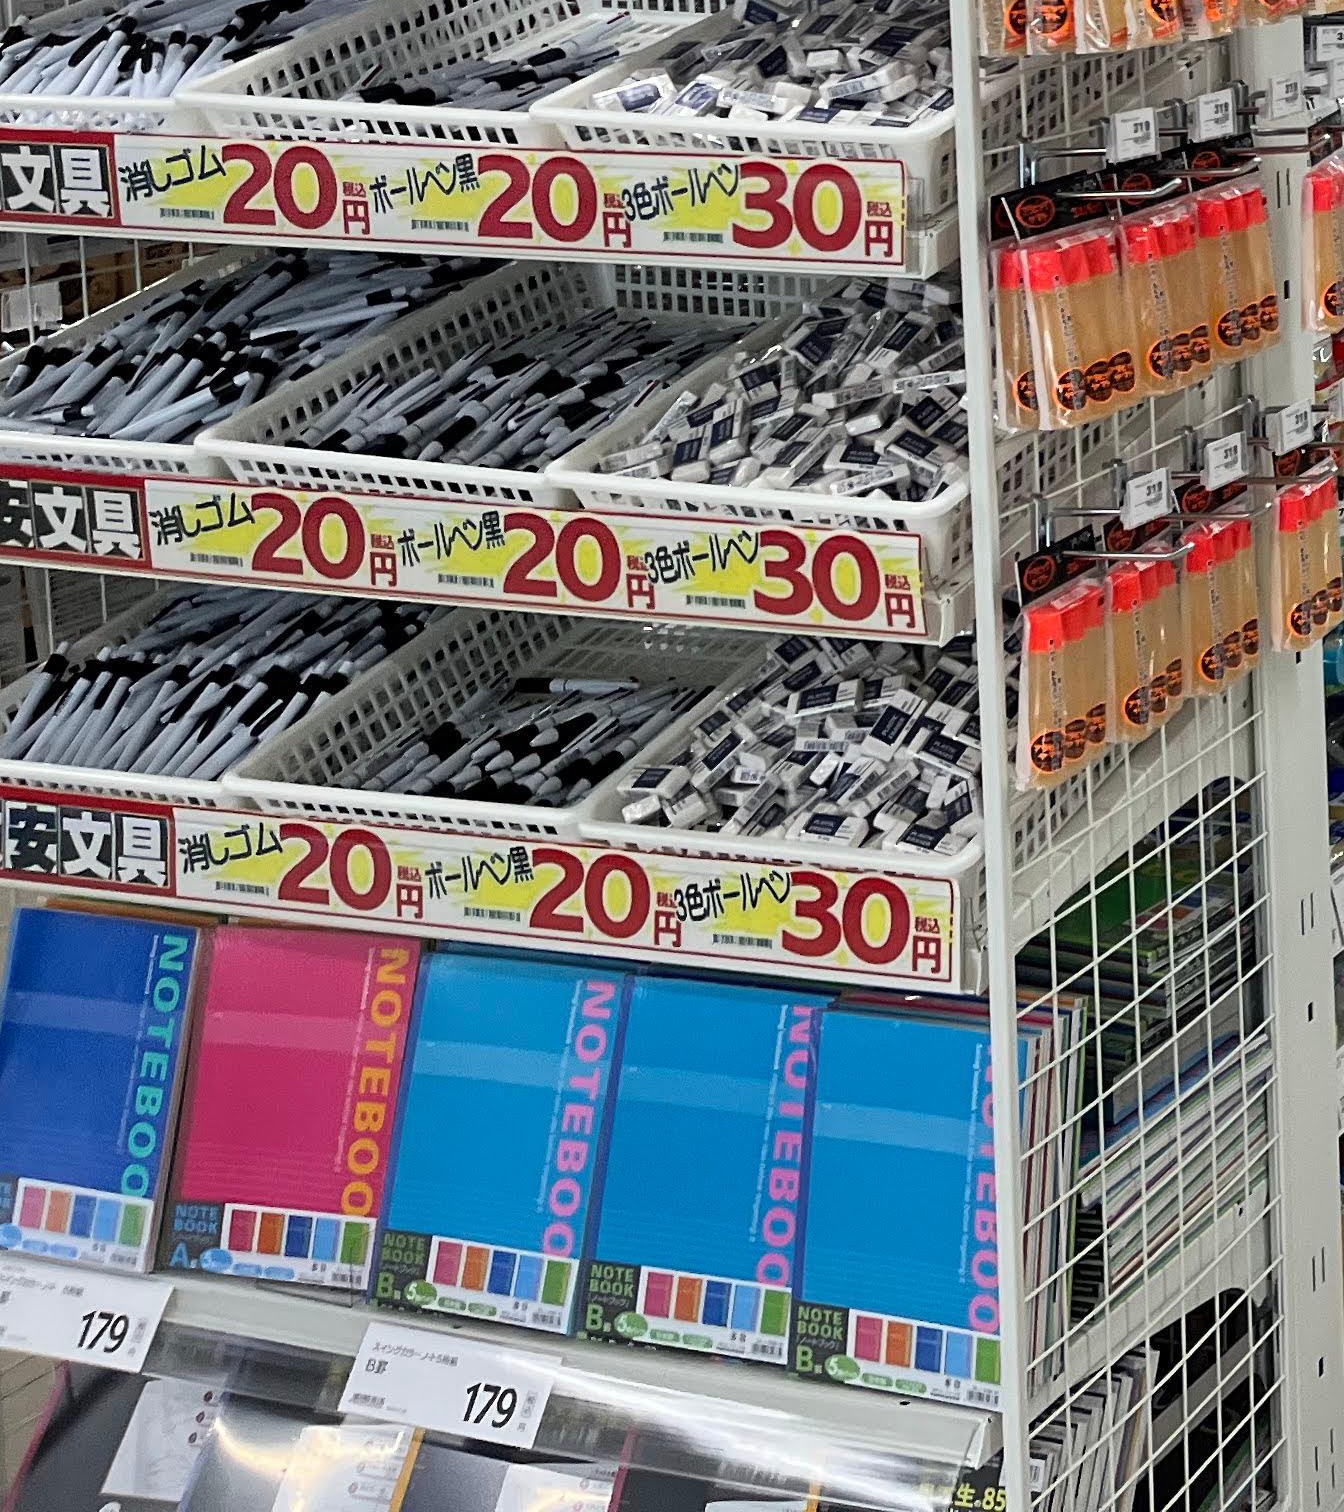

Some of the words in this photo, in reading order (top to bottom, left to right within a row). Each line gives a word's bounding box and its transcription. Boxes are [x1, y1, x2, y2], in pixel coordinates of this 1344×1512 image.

[3, 145, 114, 218] 文具
[118, 146, 227, 202] 消しゴム
[221, 143, 338, 229] 20
[342, 200, 370, 235] 円
[478, 154, 597, 242] 20
[602, 211, 632, 248] 円
[621, 163, 739, 221] 3色ボールペン
[732, 161, 863, 252] 30
[864, 221, 894, 257] 円
[150, 493, 255, 546] 消しゴム
[250, 491, 366, 581] 20
[370, 551, 398, 587] 円
[502, 511, 621, 602] 20
[625, 573, 657, 610] 円
[646, 530, 759, 585] 3色ボールペン
[753, 529, 882, 621] 30
[884, 593, 915, 628] 円
[177, 822, 282, 873] 消しゴム
[277, 821, 392, 911] 20
[396, 882, 425, 920] 円
[529, 847, 651, 939] 20
[653, 909, 683, 947] 円
[673, 869, 793, 923] 3色ボールペン
[781, 870, 911, 965] 30
[911, 934, 942, 973] 円
[120, 935, 190, 1197] NOTEBOO
[340, 948, 411, 1215] NOTEBOO
[541, 981, 617, 1260] NOTEBOO
[755, 1005, 816, 1287] NOTEBOO
[589, 1264, 635, 1282] NOTE
[589, 1279, 634, 1297] BOOK
[76, 1311, 130, 1355] 179
[797, 1322, 844, 1340] BOOK
[798, 1305, 843, 1326] NOTE
[796, 1347, 814, 1372] B
[461, 1383, 518, 1428] 179
